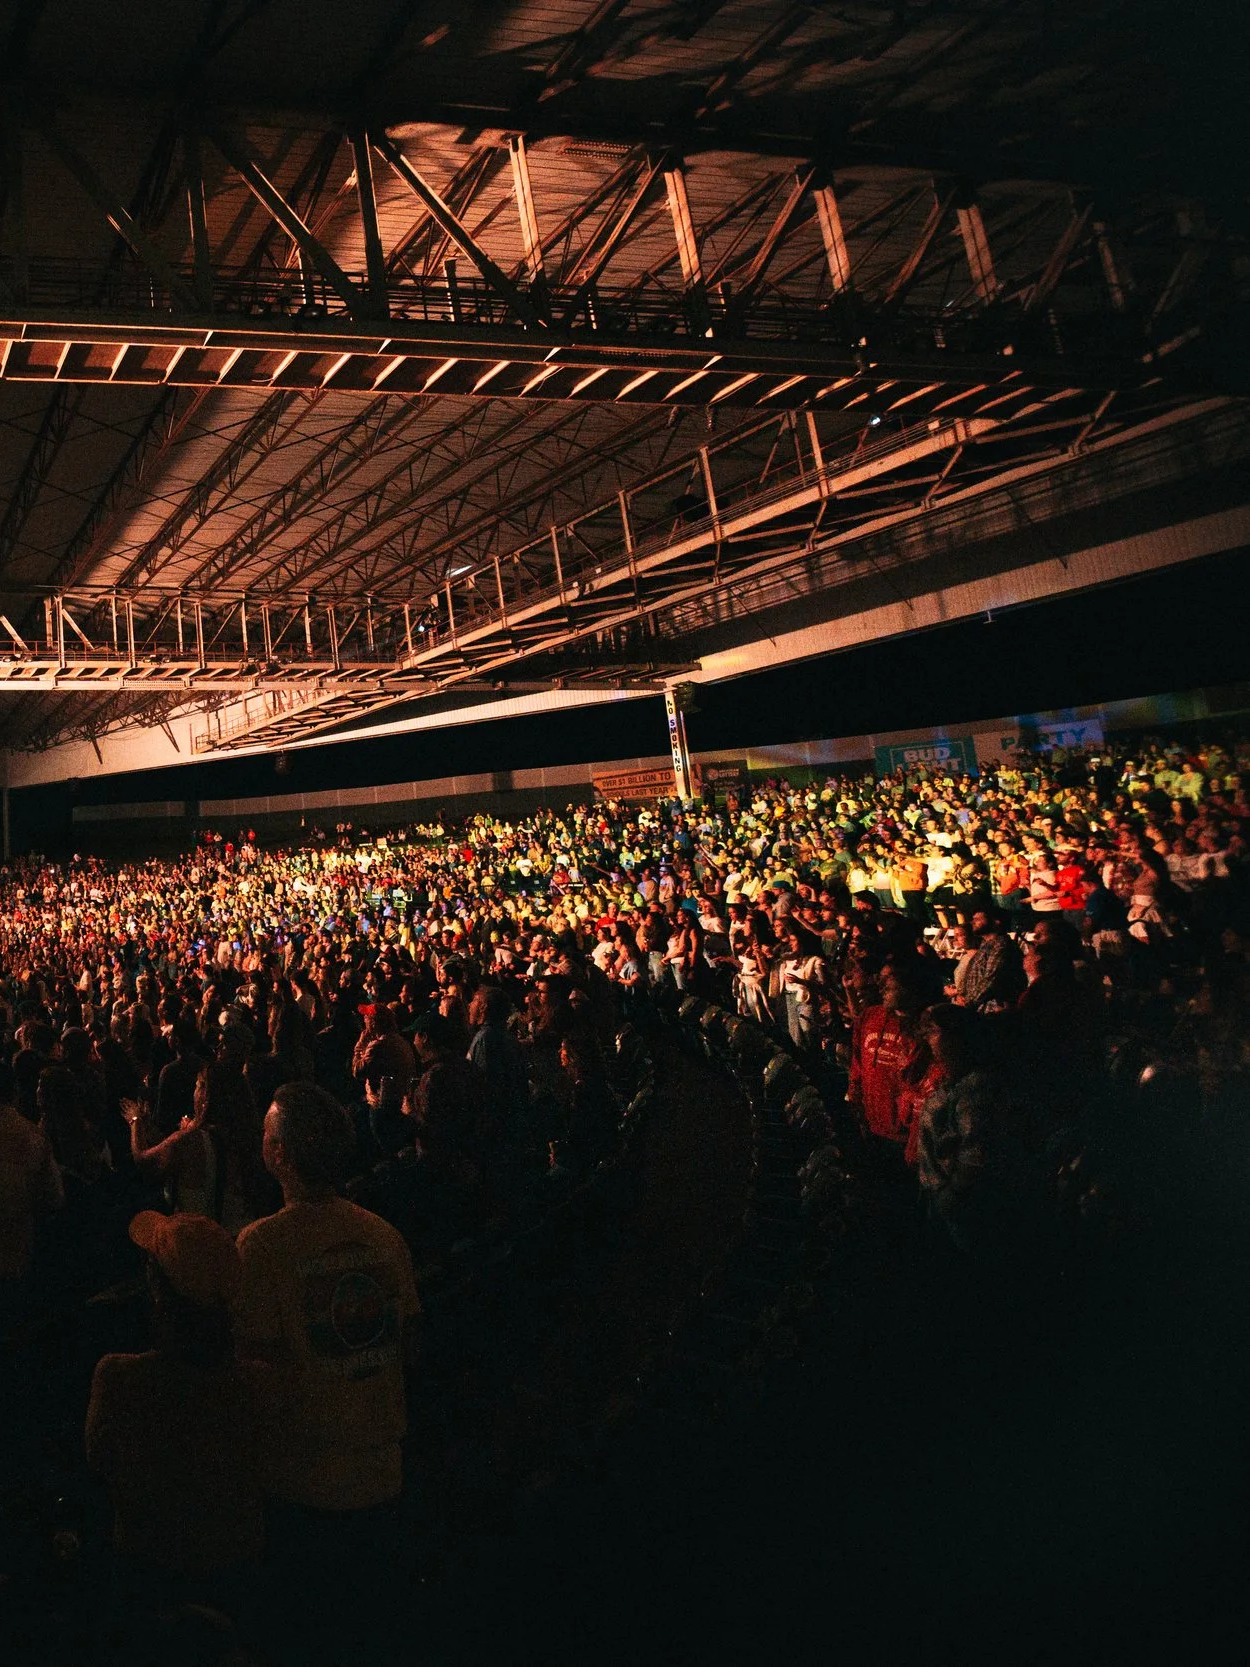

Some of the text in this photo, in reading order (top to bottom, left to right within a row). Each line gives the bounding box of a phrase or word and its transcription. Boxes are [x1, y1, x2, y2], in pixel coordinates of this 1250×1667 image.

[667, 700, 681, 773] NO SMOKING
[903, 747, 950, 763] BUD
[618, 778, 626, 786] $1
[627, 774, 657, 785] BILLION
[659, 772, 671, 781] TO
[631, 788, 647, 796] LAST
[649, 787, 669, 795] YEAR
